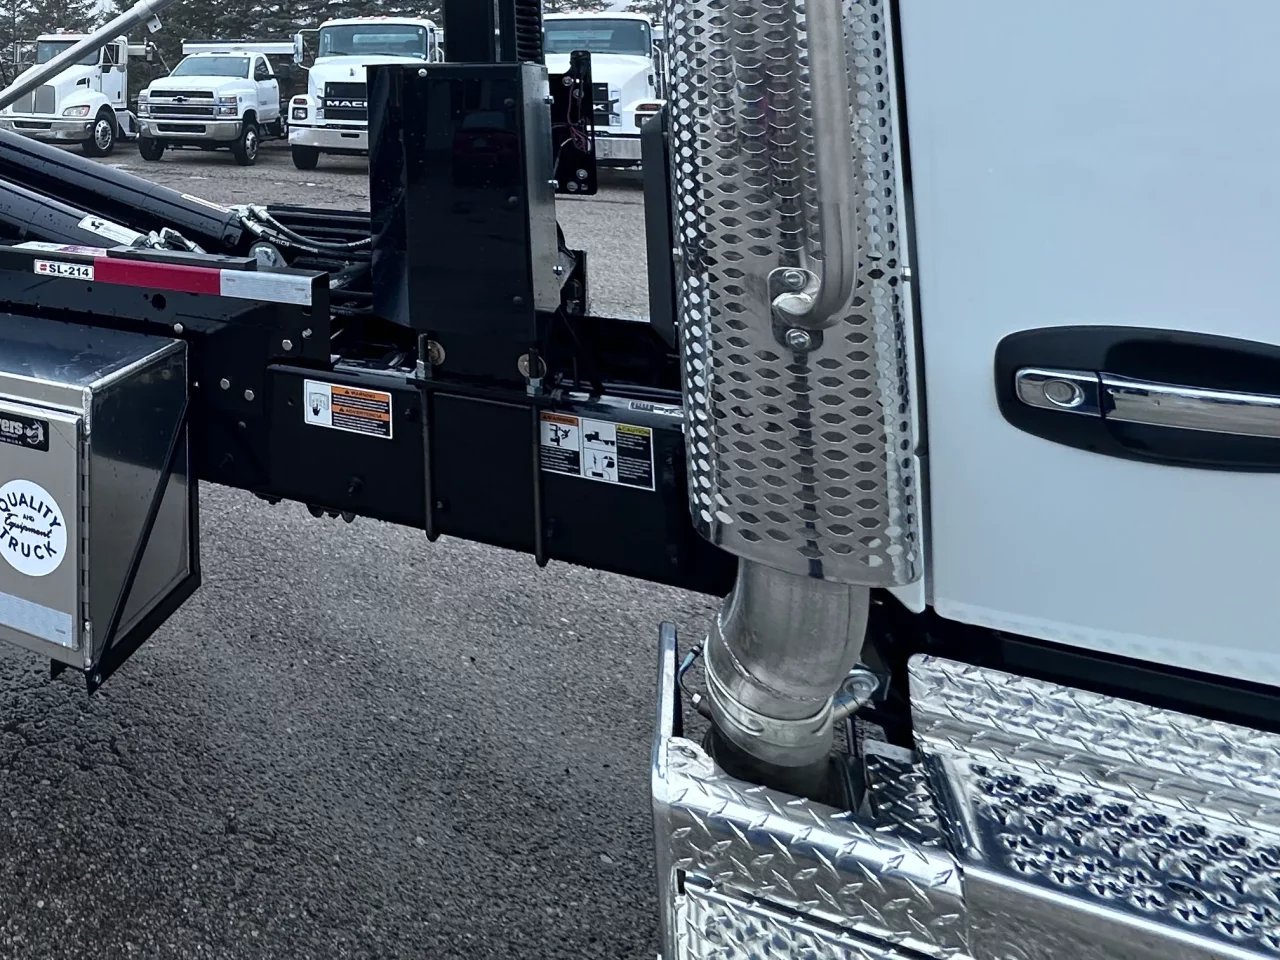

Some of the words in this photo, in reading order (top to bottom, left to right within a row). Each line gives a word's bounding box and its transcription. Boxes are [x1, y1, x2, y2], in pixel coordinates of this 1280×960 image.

[49, 264, 89, 277] SL-214
[4, 512, 53, 539] Equipment
[22, 514, 35, 522] AND
[0, 526, 58, 560] TRUCK
